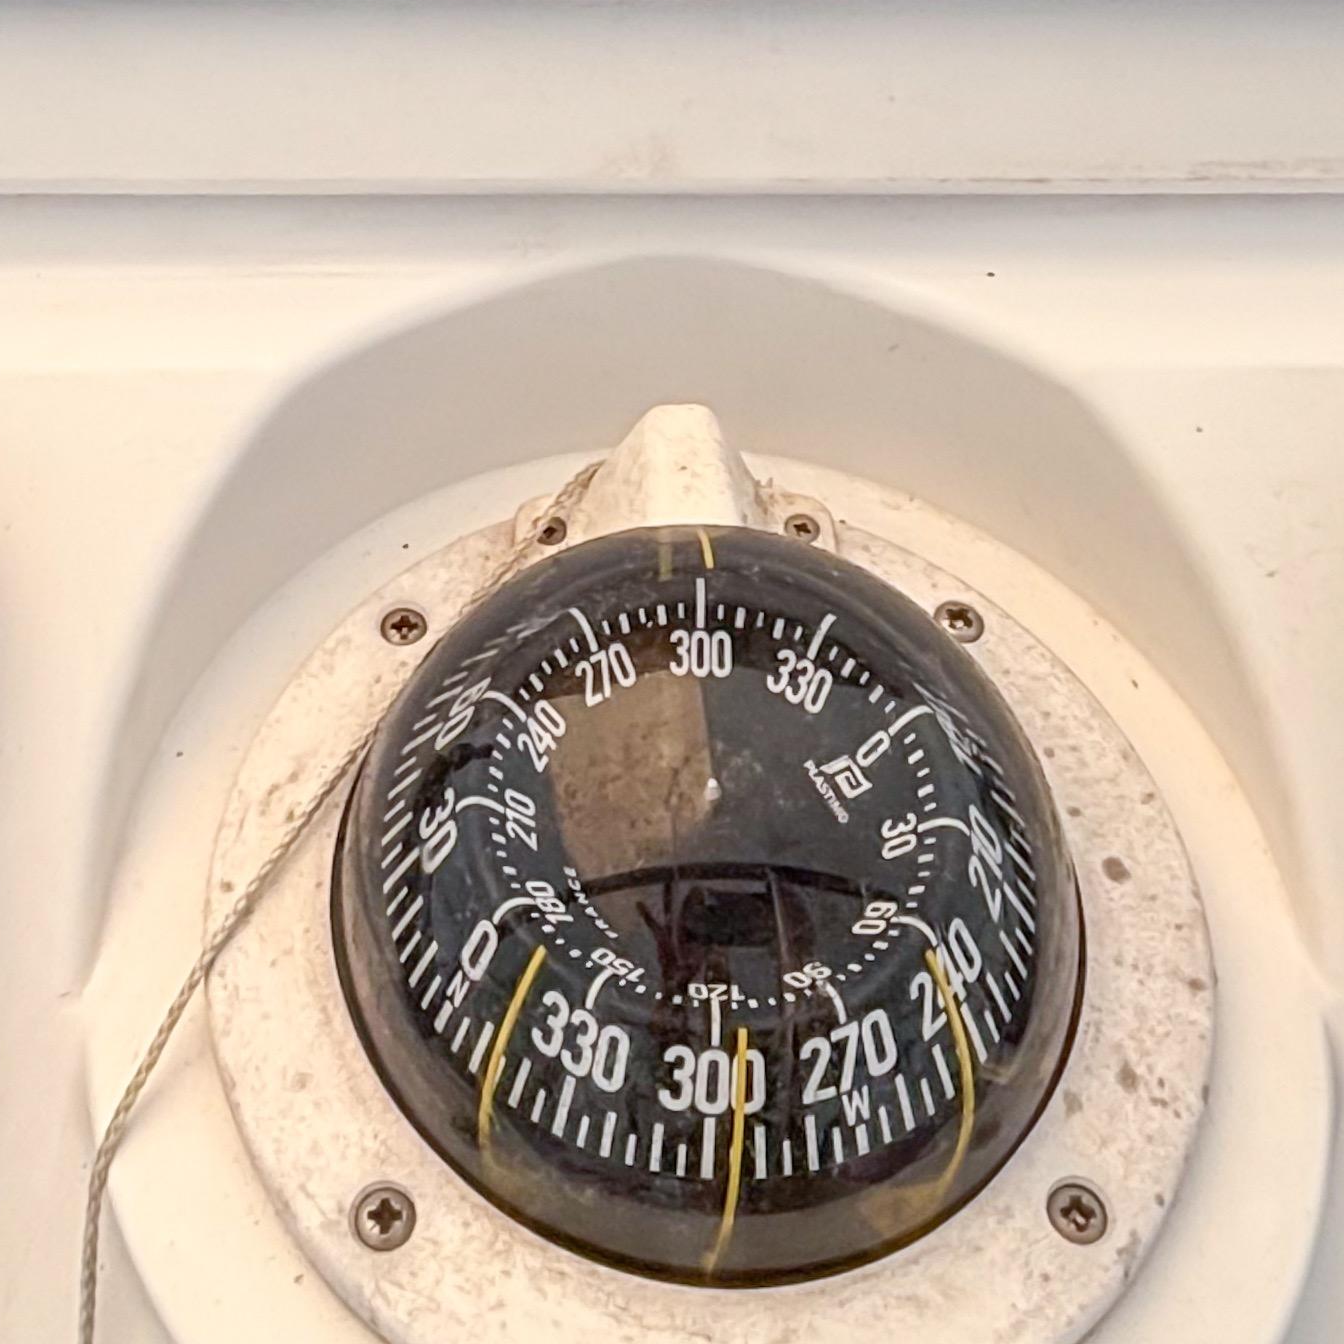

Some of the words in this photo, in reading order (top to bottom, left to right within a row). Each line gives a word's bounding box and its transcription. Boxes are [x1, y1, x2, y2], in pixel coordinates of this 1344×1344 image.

[574, 643, 638, 708] 270
[669, 629, 733, 678] 300
[766, 648, 834, 715] 330
[516, 699, 567, 774] 240
[504, 788, 538, 852] 210
[880, 812, 918, 860] 30
[525, 880, 575, 925] 180
[851, 900, 899, 936] 60
[531, 989, 631, 1094] 330
[799, 1008, 899, 1105] 270
[659, 1044, 766, 1115] 300
[841, 1084, 871, 1128] W
